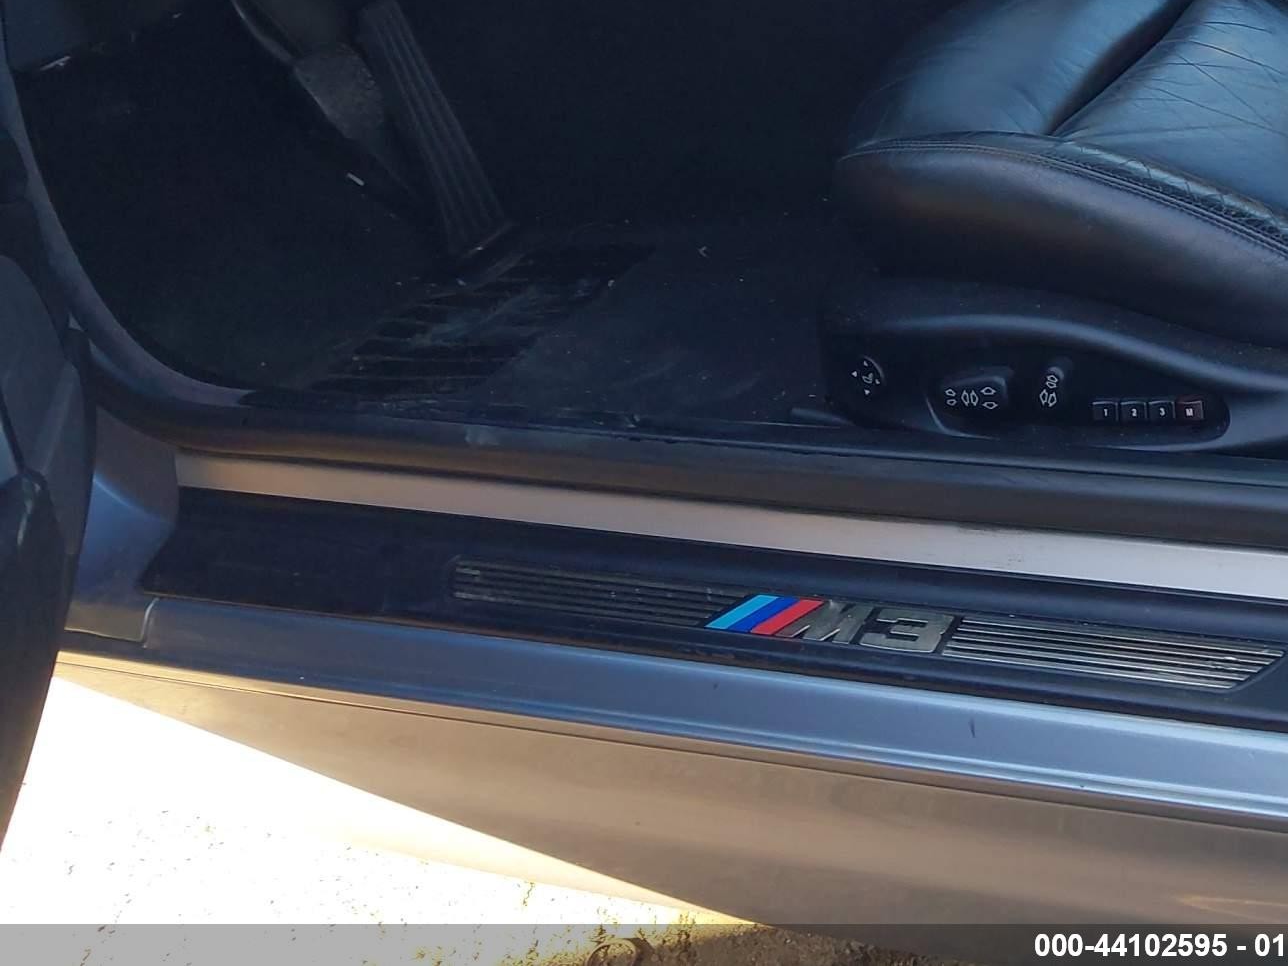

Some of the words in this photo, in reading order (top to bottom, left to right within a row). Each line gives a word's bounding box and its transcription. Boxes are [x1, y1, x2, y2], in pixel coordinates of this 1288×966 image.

[1131, 408, 1137, 417] 2
[1159, 407, 1166, 417] 3
[773, 601, 954, 653] M3
